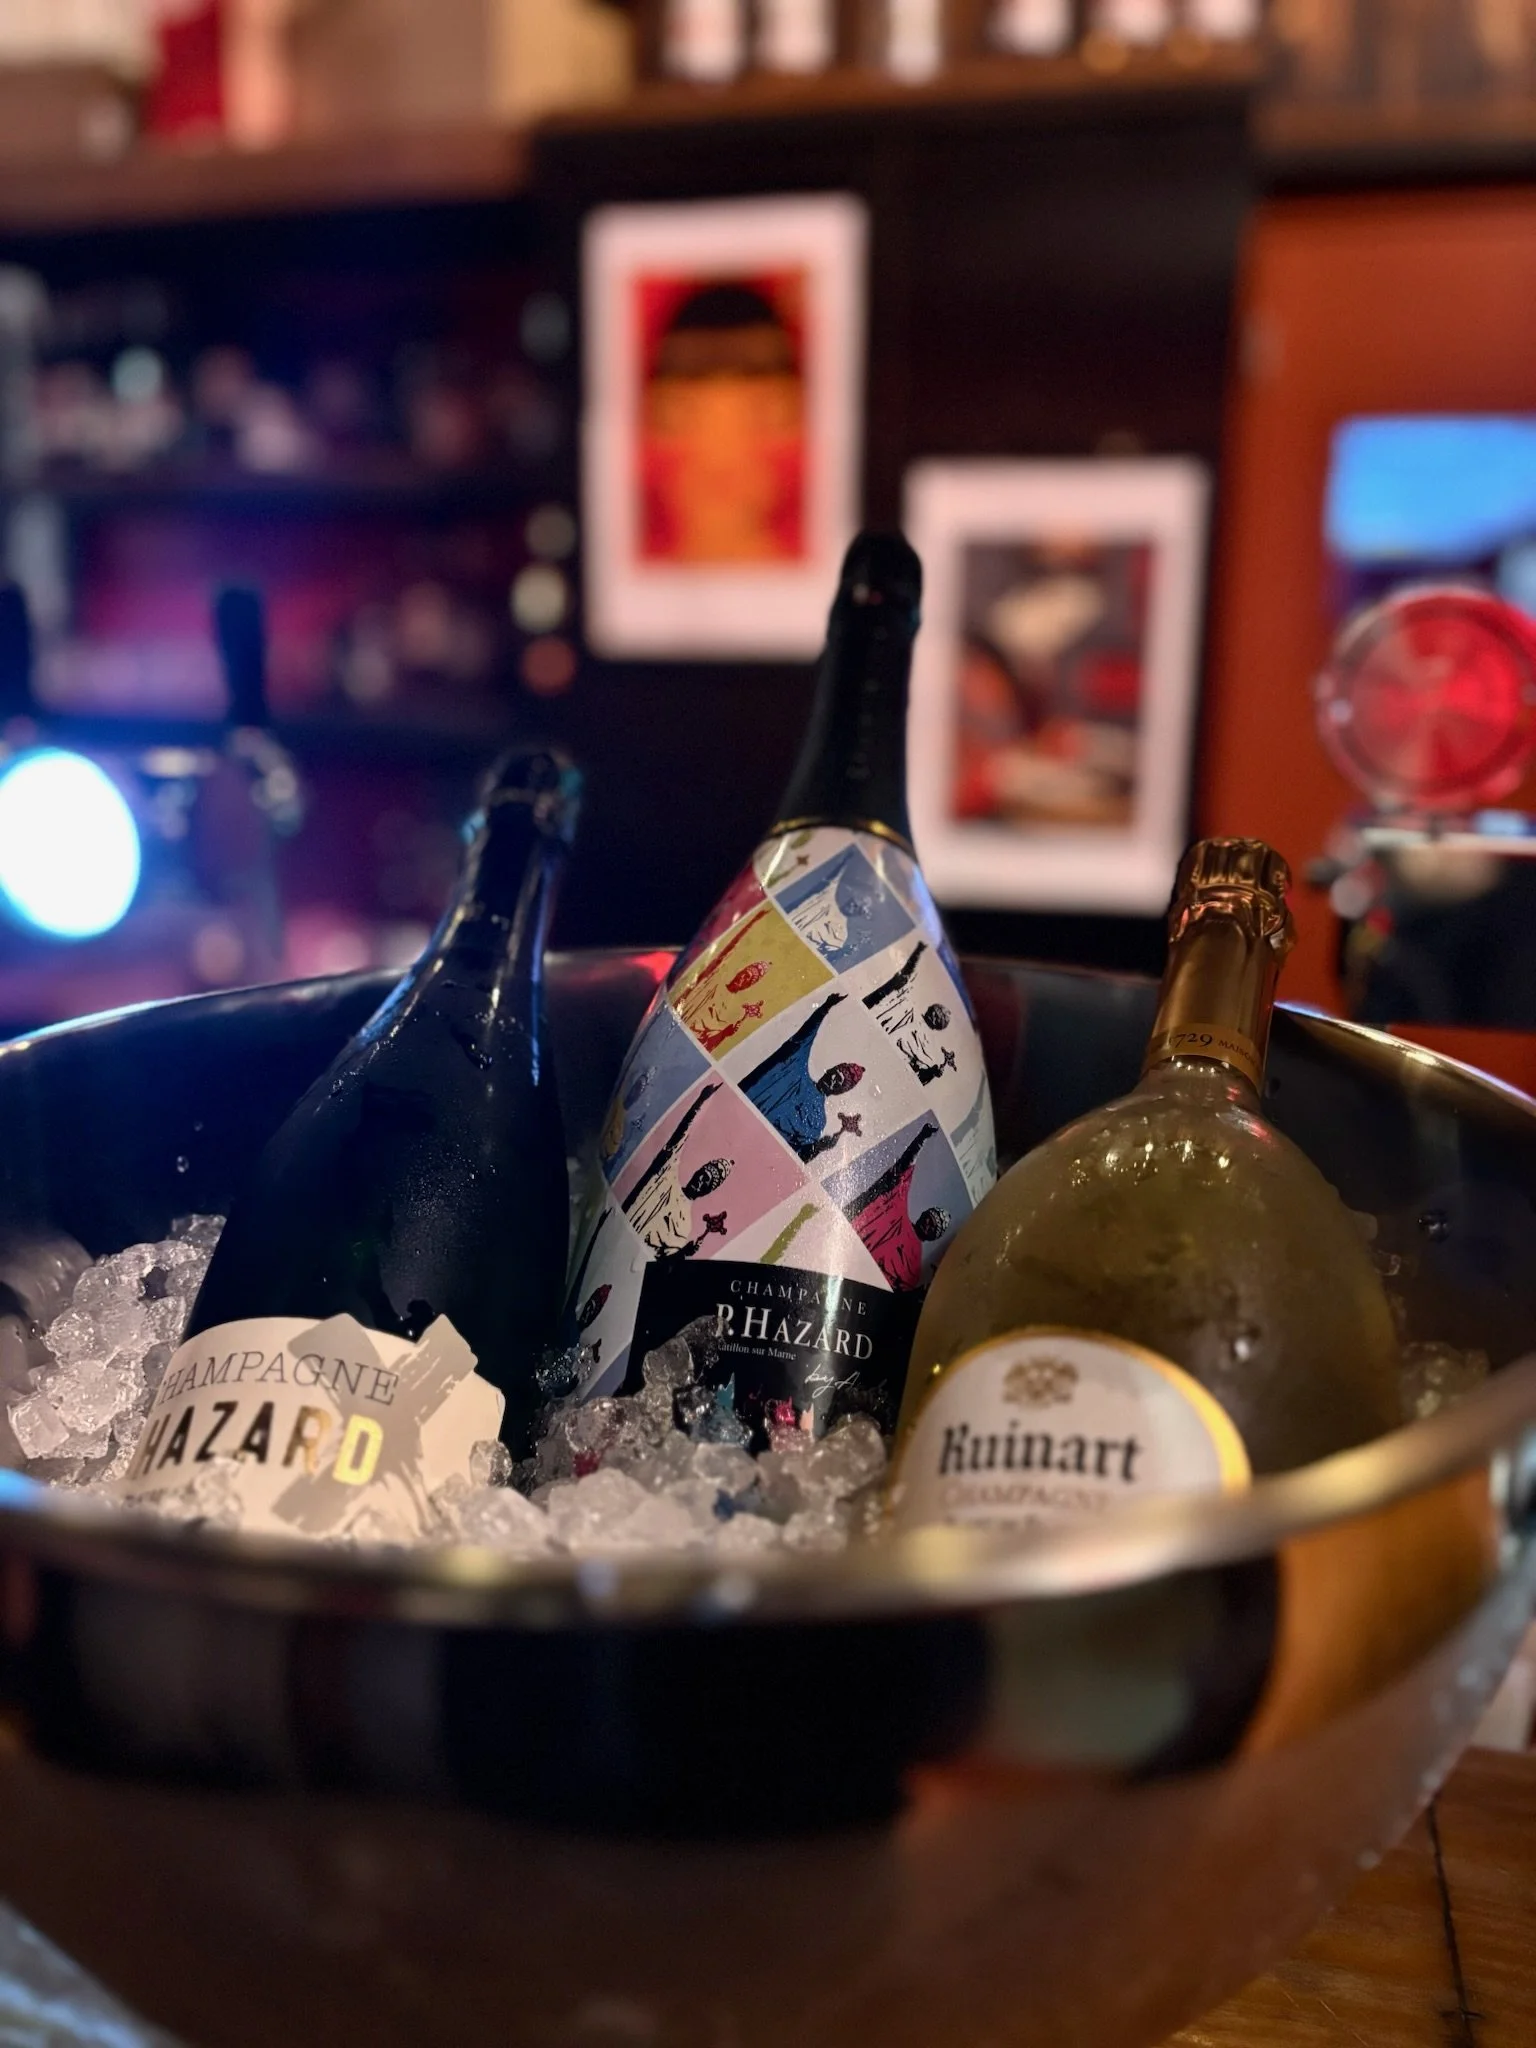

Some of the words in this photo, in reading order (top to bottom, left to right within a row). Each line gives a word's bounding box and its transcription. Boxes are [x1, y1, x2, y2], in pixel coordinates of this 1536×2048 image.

[730, 1279, 868, 1316] CHAMPANE
[158, 1350, 400, 1406] HAMPAGNE
[938, 1419, 1145, 1483] Ruinart
